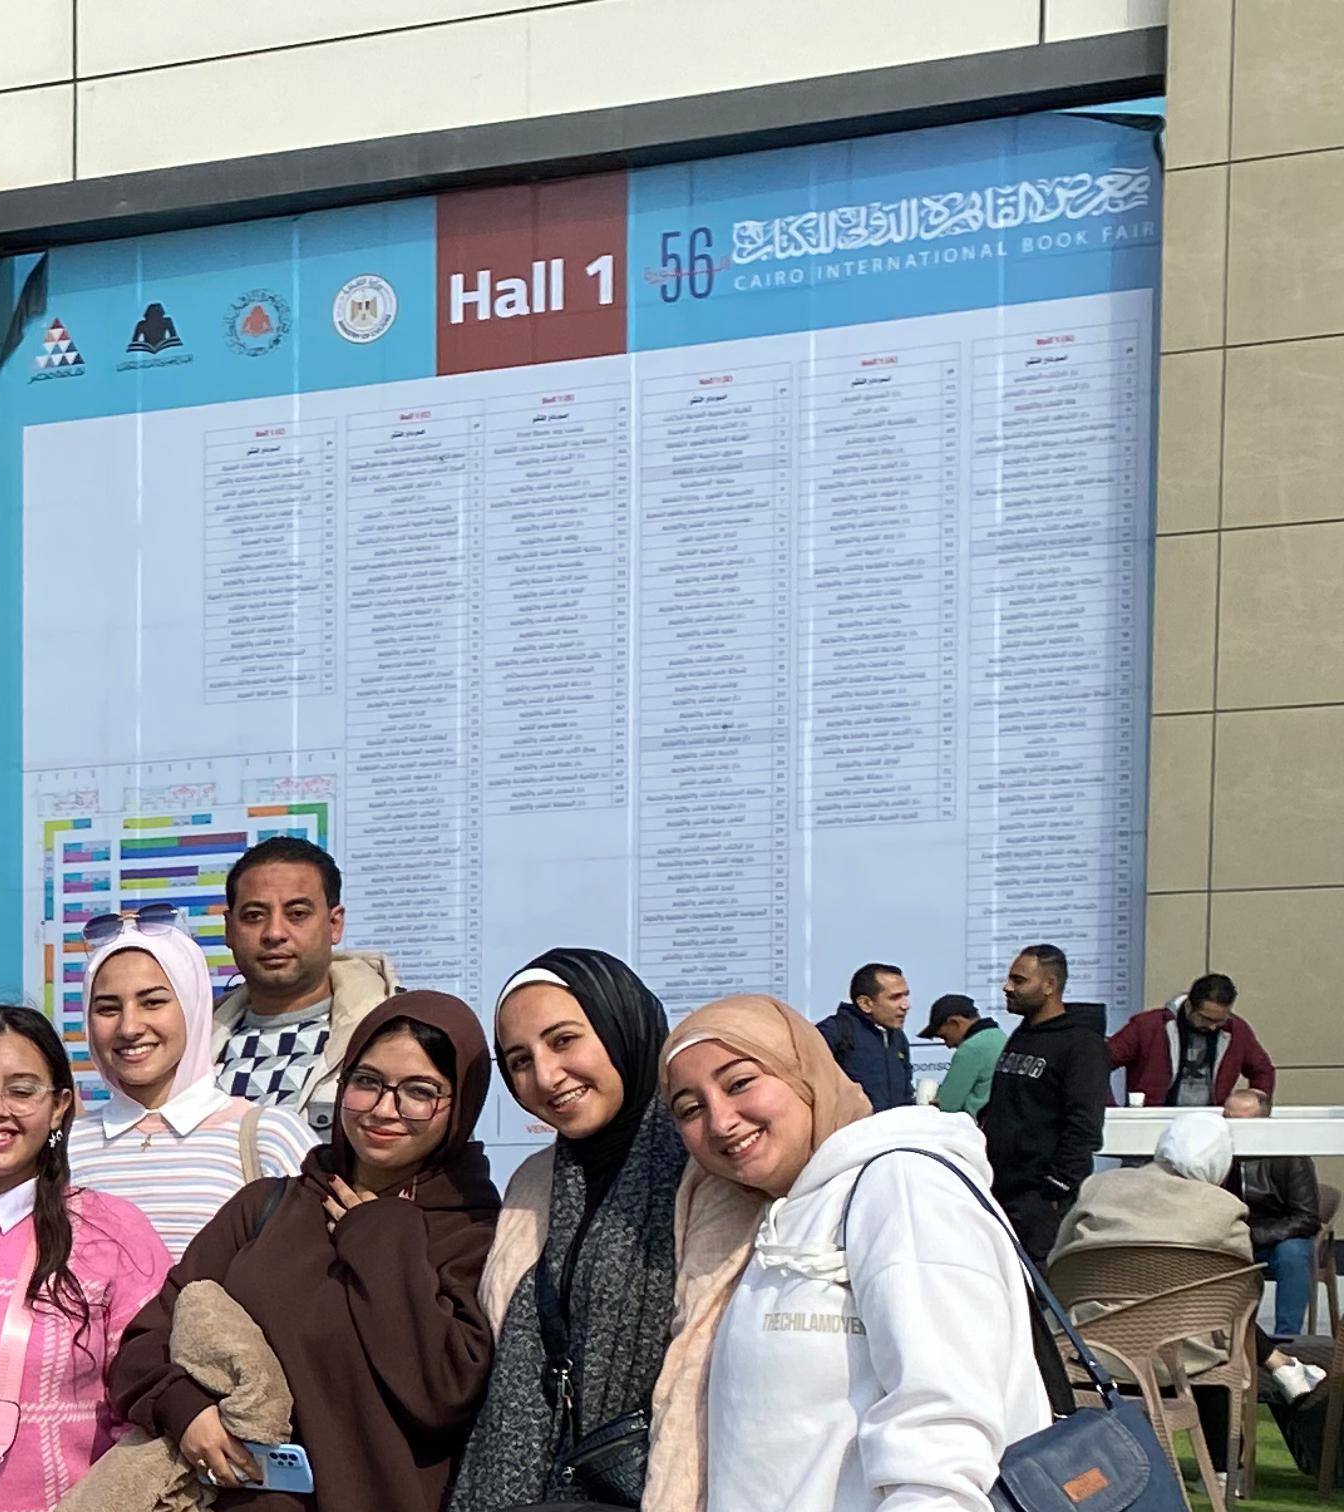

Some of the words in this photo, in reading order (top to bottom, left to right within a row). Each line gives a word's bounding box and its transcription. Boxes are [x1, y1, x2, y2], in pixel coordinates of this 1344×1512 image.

[449, 258, 564, 325] Hall
[585, 254, 614, 306] 1
[661, 227, 714, 303] 56
[734, 268, 804, 291] CAIRO
[817, 241, 1008, 281] INTERNATIONAL
[1021, 230, 1089, 253] BOOK
[1102, 221, 1155, 243] FAIR
